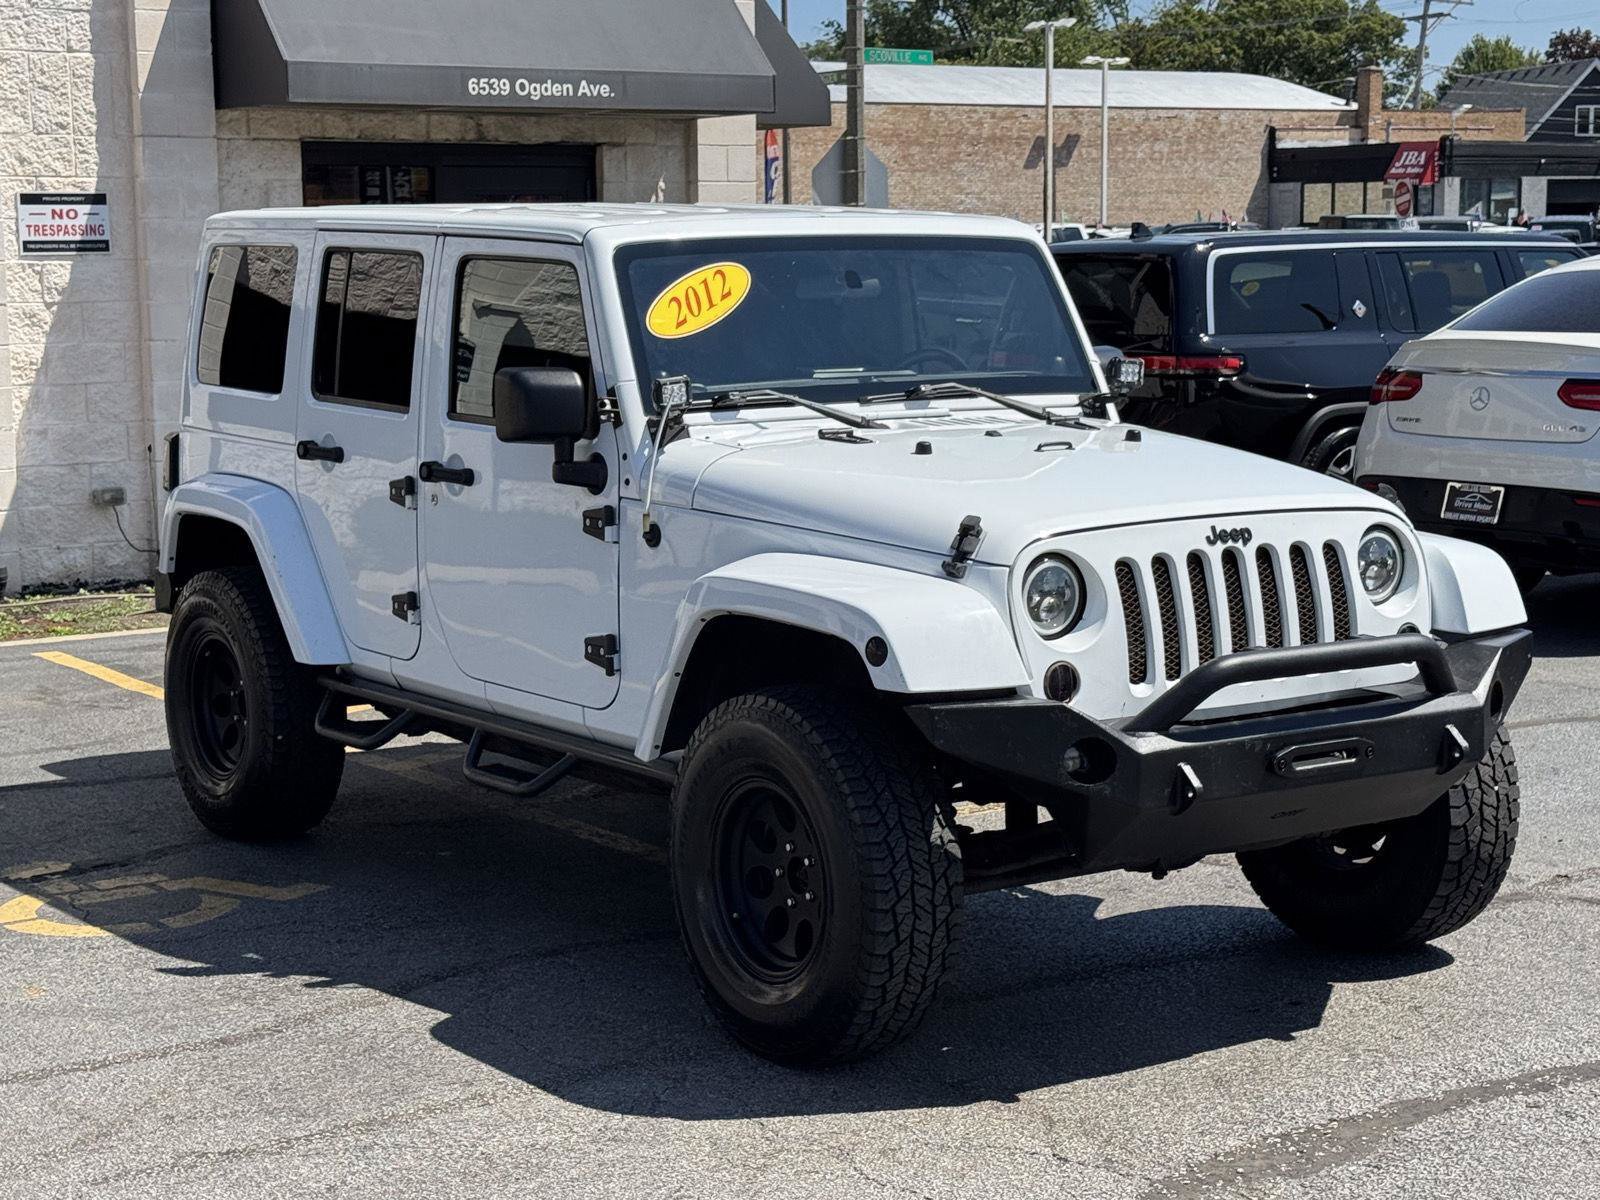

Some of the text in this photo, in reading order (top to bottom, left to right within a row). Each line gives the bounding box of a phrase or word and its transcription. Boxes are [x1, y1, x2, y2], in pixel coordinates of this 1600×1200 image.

[868, 50, 912, 63] SCOVILLE
[467, 77, 615, 100] 6539 Ogden Ave.
[1394, 151, 1427, 167] JBA
[51, 208, 79, 220] NO
[25, 224, 105, 236] TRESPASSING
[667, 268, 733, 330] 2012
[1454, 500, 1472, 508] Drive
[1473, 502, 1493, 511] Motor
[1205, 525, 1252, 548] Jeep
